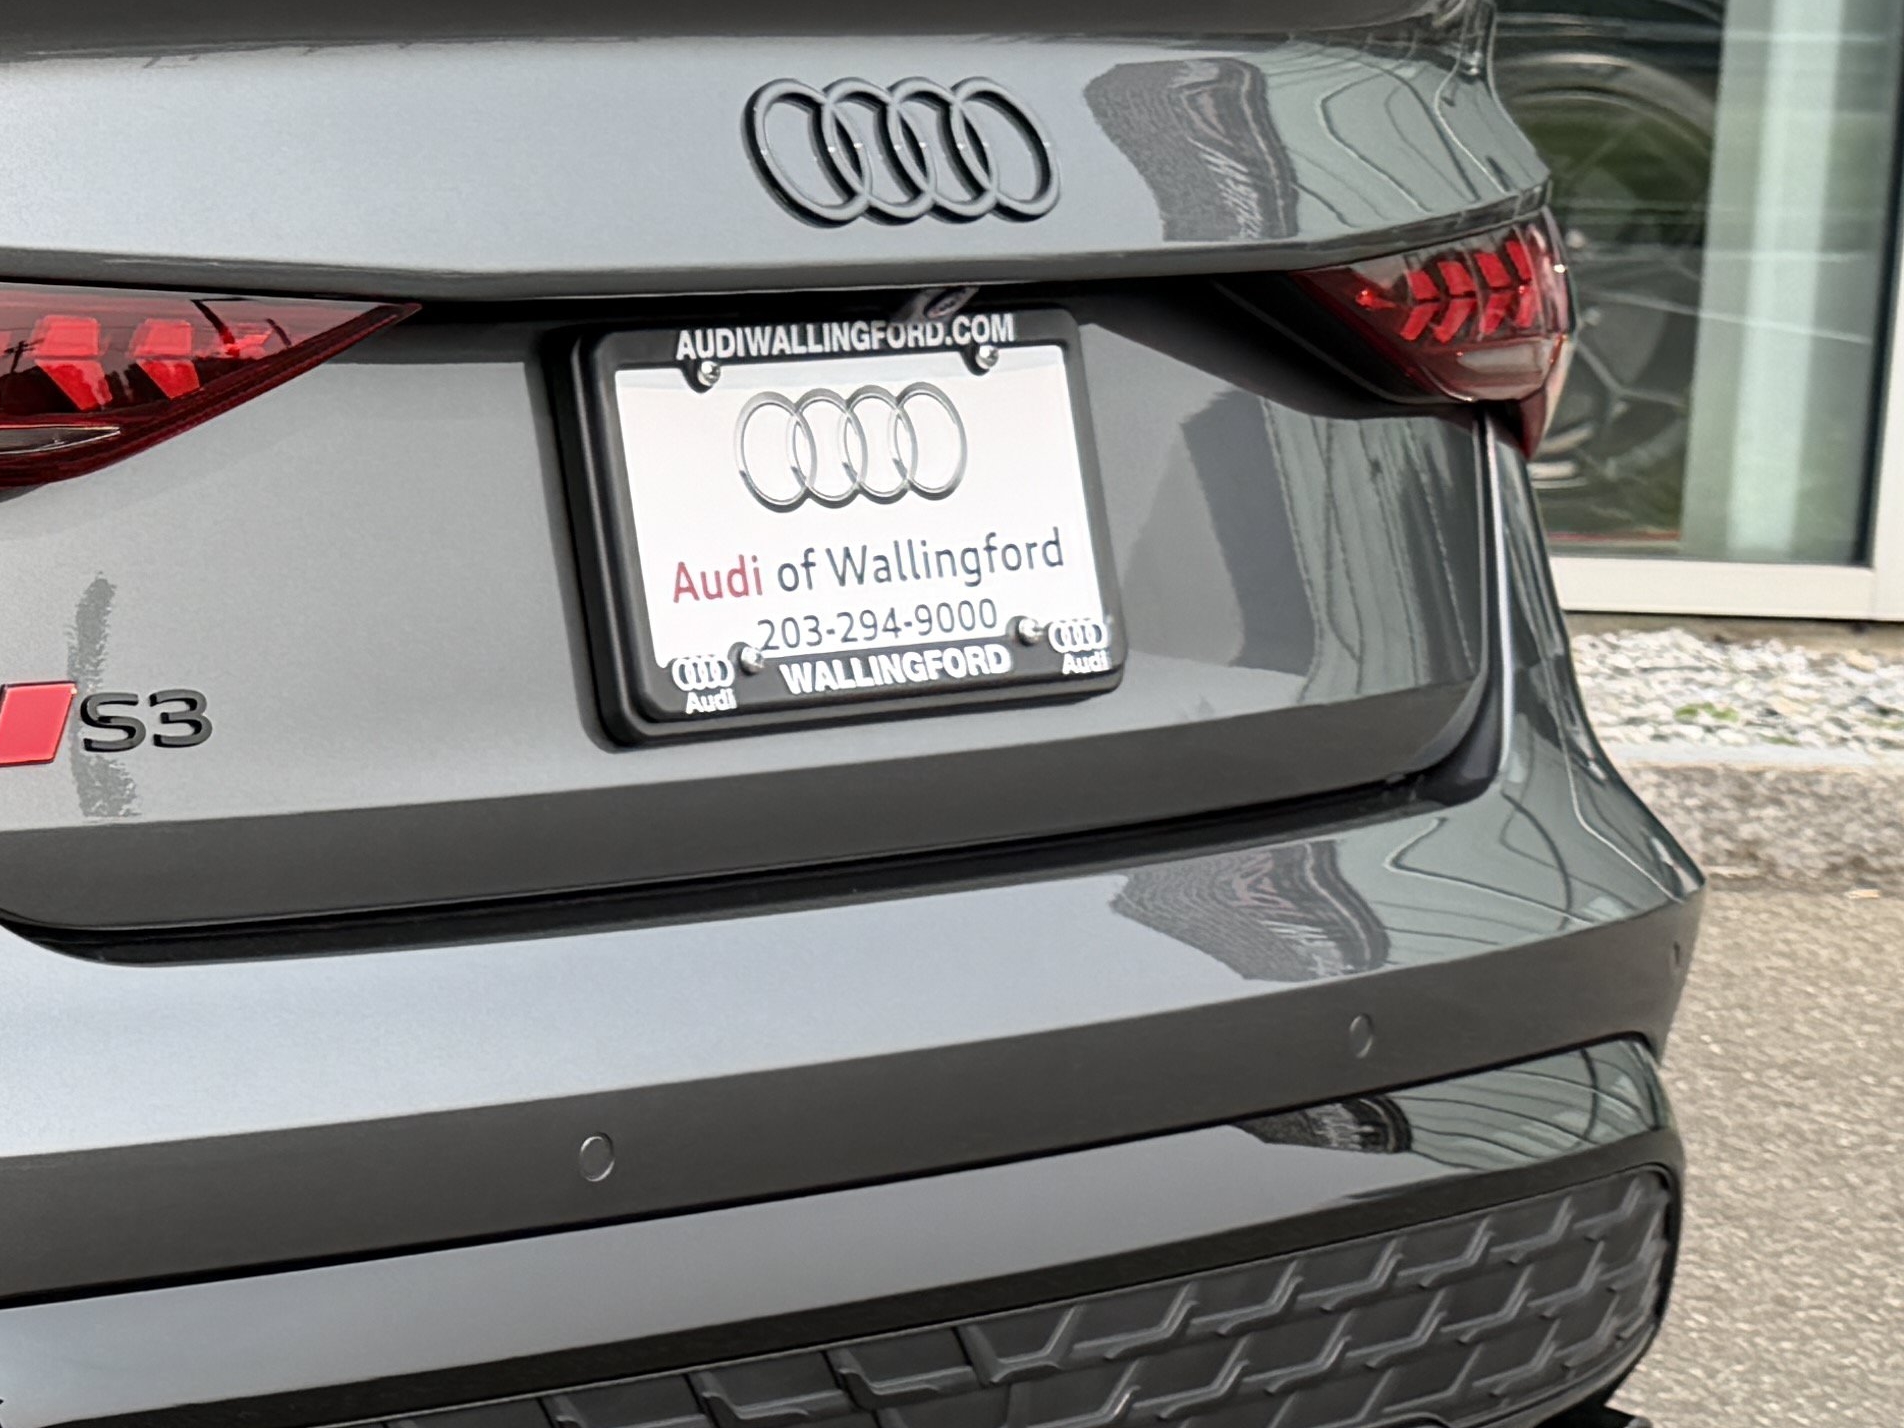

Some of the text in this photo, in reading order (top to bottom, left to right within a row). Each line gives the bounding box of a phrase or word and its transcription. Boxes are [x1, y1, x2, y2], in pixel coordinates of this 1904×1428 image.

[676, 313, 1016, 360] AUDIWALLINGFORD.COM
[672, 527, 1065, 603] Audi of Wallingford
[757, 598, 997, 651] 203-294-9000
[779, 644, 1012, 695] WALLINGFORD
[1062, 650, 1110, 675] Audi
[80, 689, 213, 753] S3
[685, 688, 738, 715] Audi
